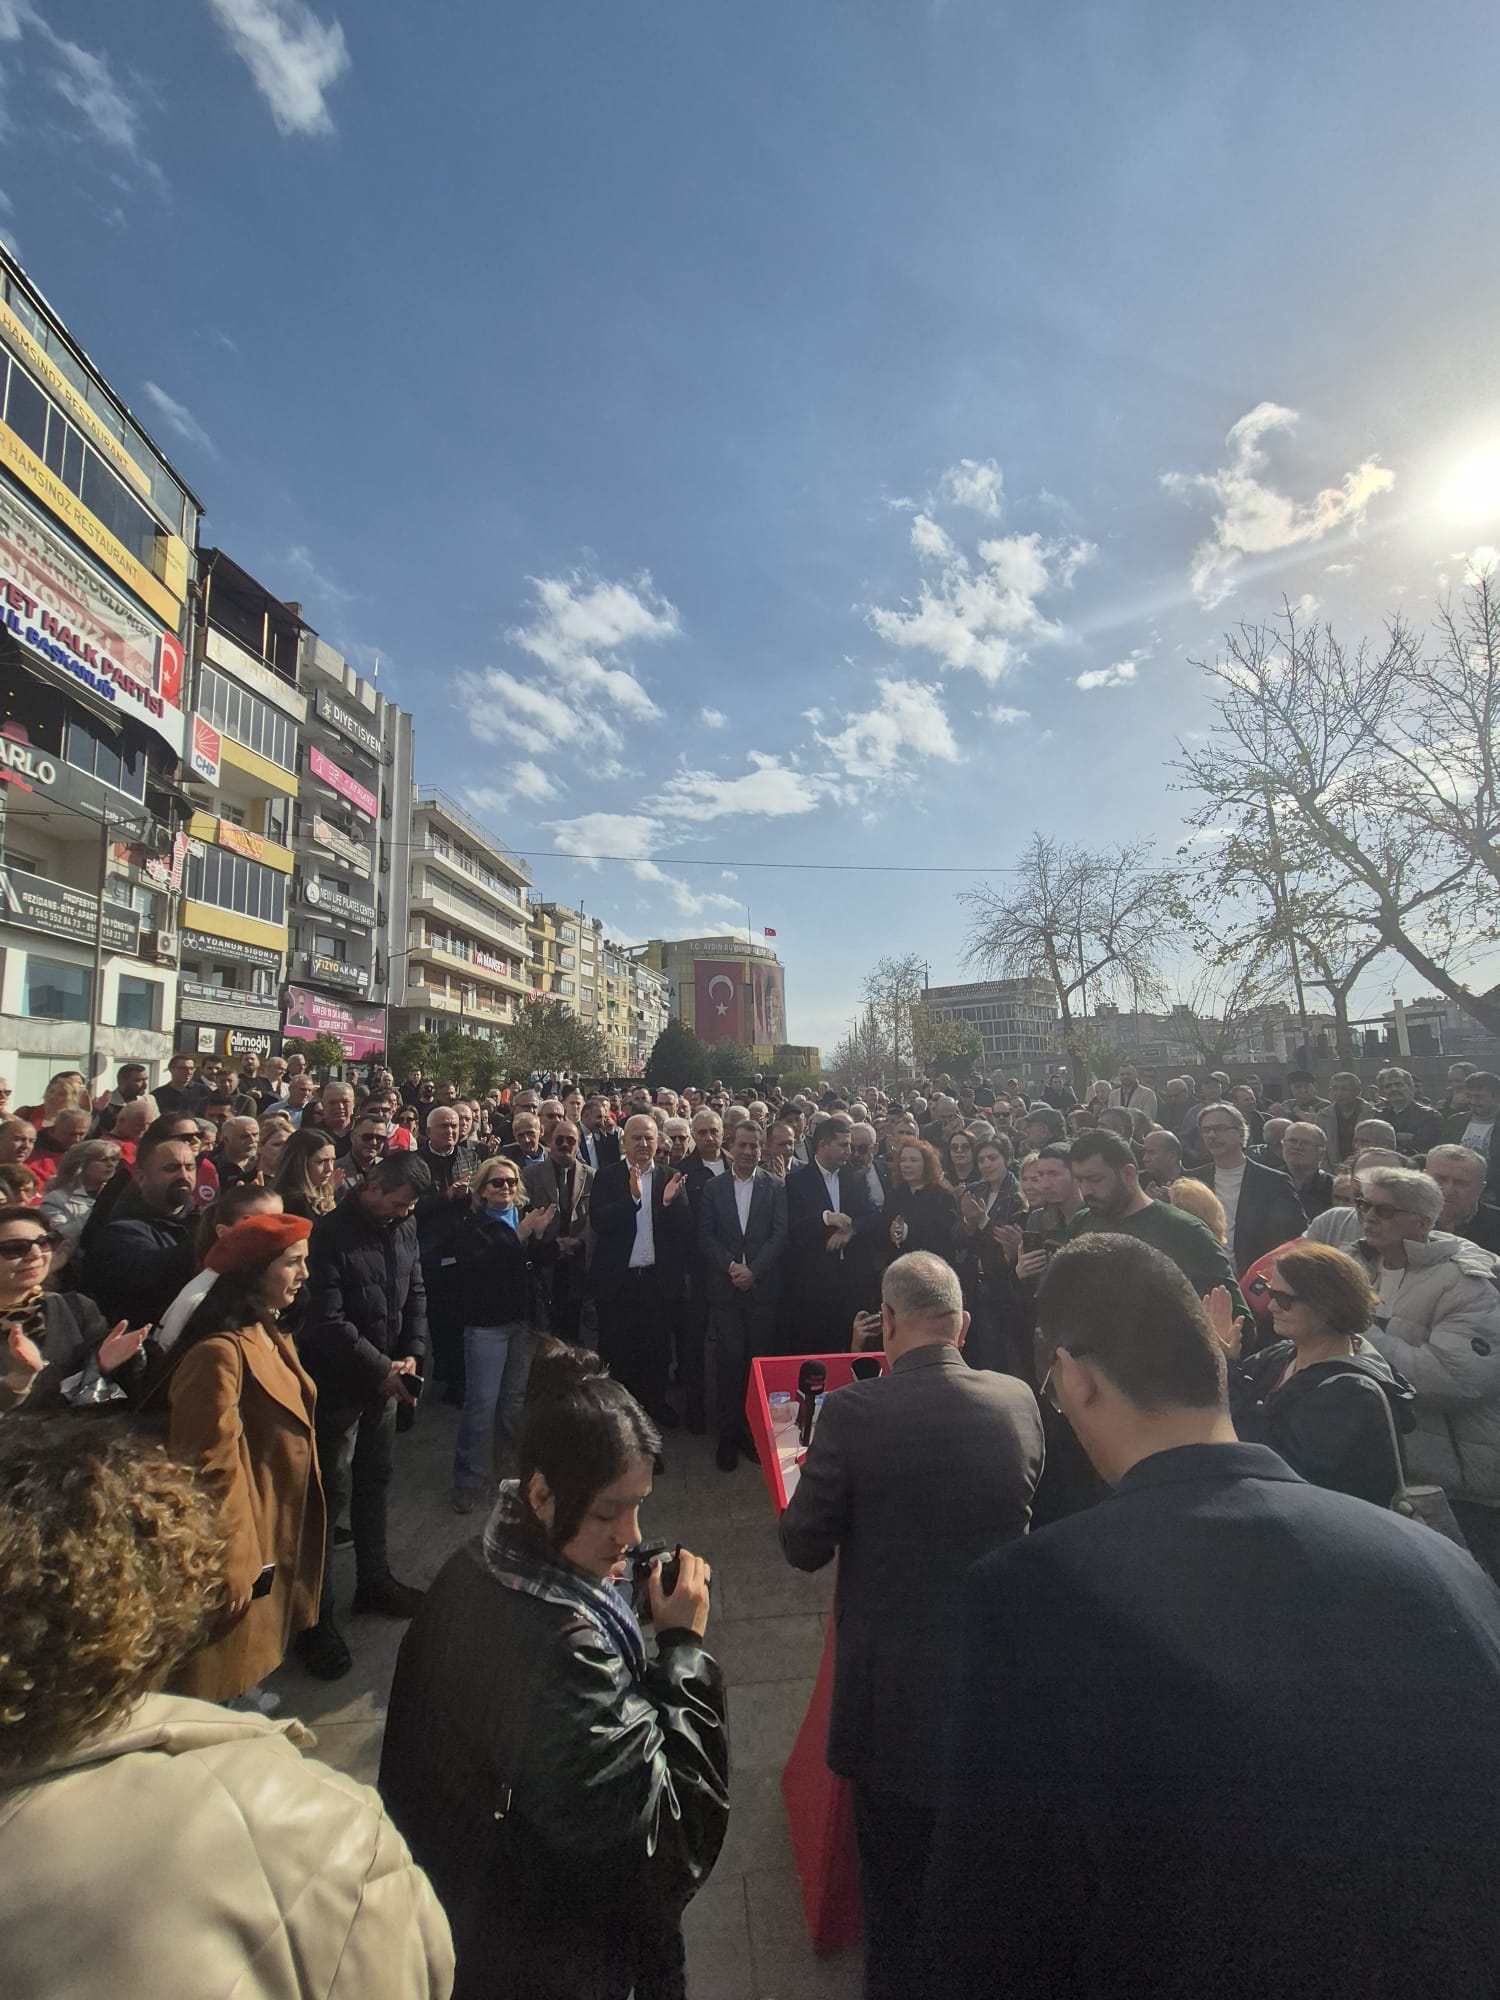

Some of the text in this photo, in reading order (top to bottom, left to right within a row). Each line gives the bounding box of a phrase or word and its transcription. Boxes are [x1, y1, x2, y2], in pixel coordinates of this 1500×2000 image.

[73, 507, 139, 580] RESTAURANT
[6, 608, 24, 636] İL
[25, 626, 116, 701] BAŞKANLIĞI
[41, 610, 99, 669] HALK
[101, 656, 164, 718] PARTİSİ
[195, 754, 217, 776] CHP
[320, 888, 375, 918] NEW LIFE PILATES CENTER
[198, 935, 243, 953] AYDANUR
